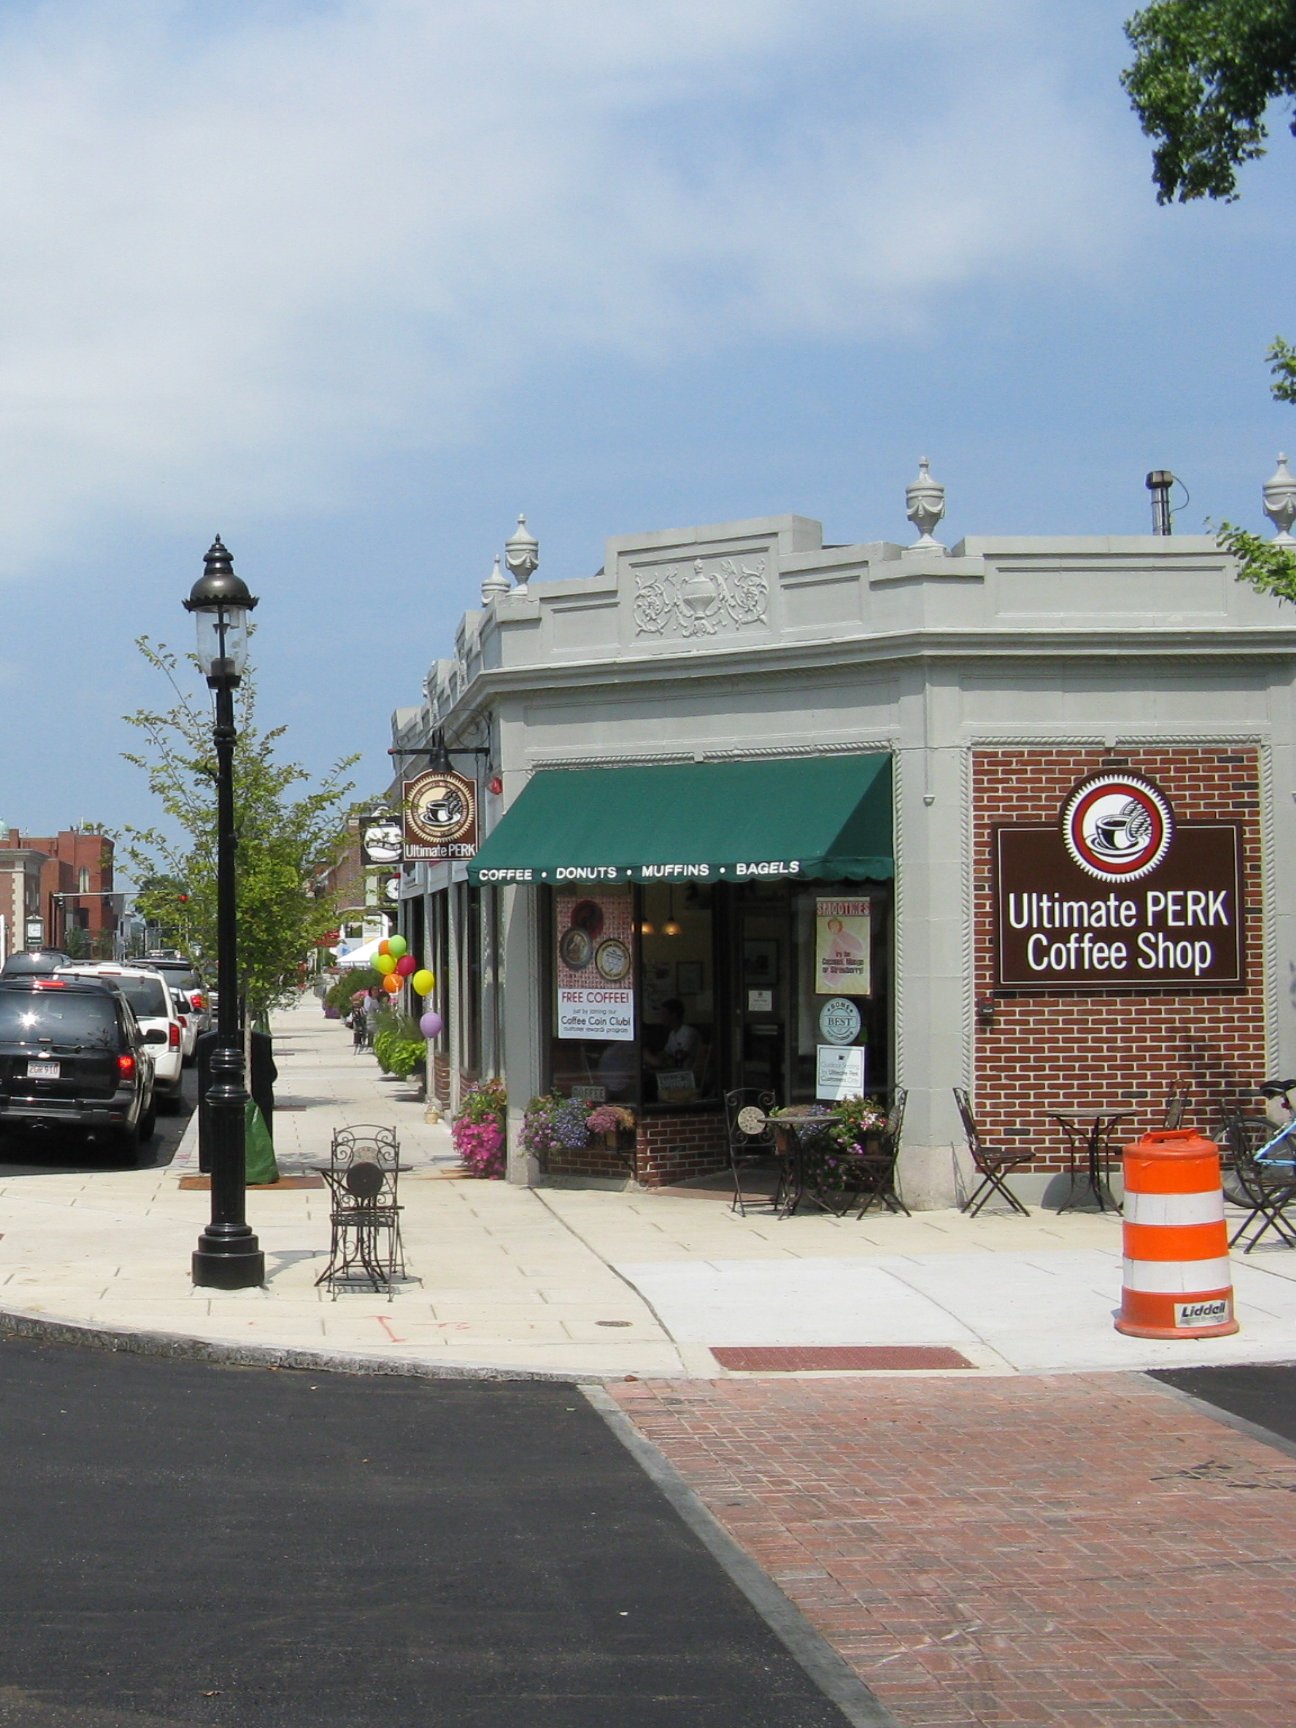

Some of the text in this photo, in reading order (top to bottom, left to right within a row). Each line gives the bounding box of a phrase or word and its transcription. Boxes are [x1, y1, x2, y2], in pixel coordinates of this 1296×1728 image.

[406, 844, 448, 857] Ultimate
[448, 843, 476, 857] PERK
[479, 861, 800, 881] COFFEE DONUTS MUFFINS BAGELS
[1008, 890, 1229, 929] Ultimate PERK
[1027, 931, 1212, 977] Coffee Shop
[561, 992, 630, 1004] FREE COFFEE!
[561, 1016, 587, 1025] Coffee
[588, 1016, 607, 1026] Coin
[828, 1017, 853, 1026] BEST
[1181, 1302, 1226, 1318] Liddell
